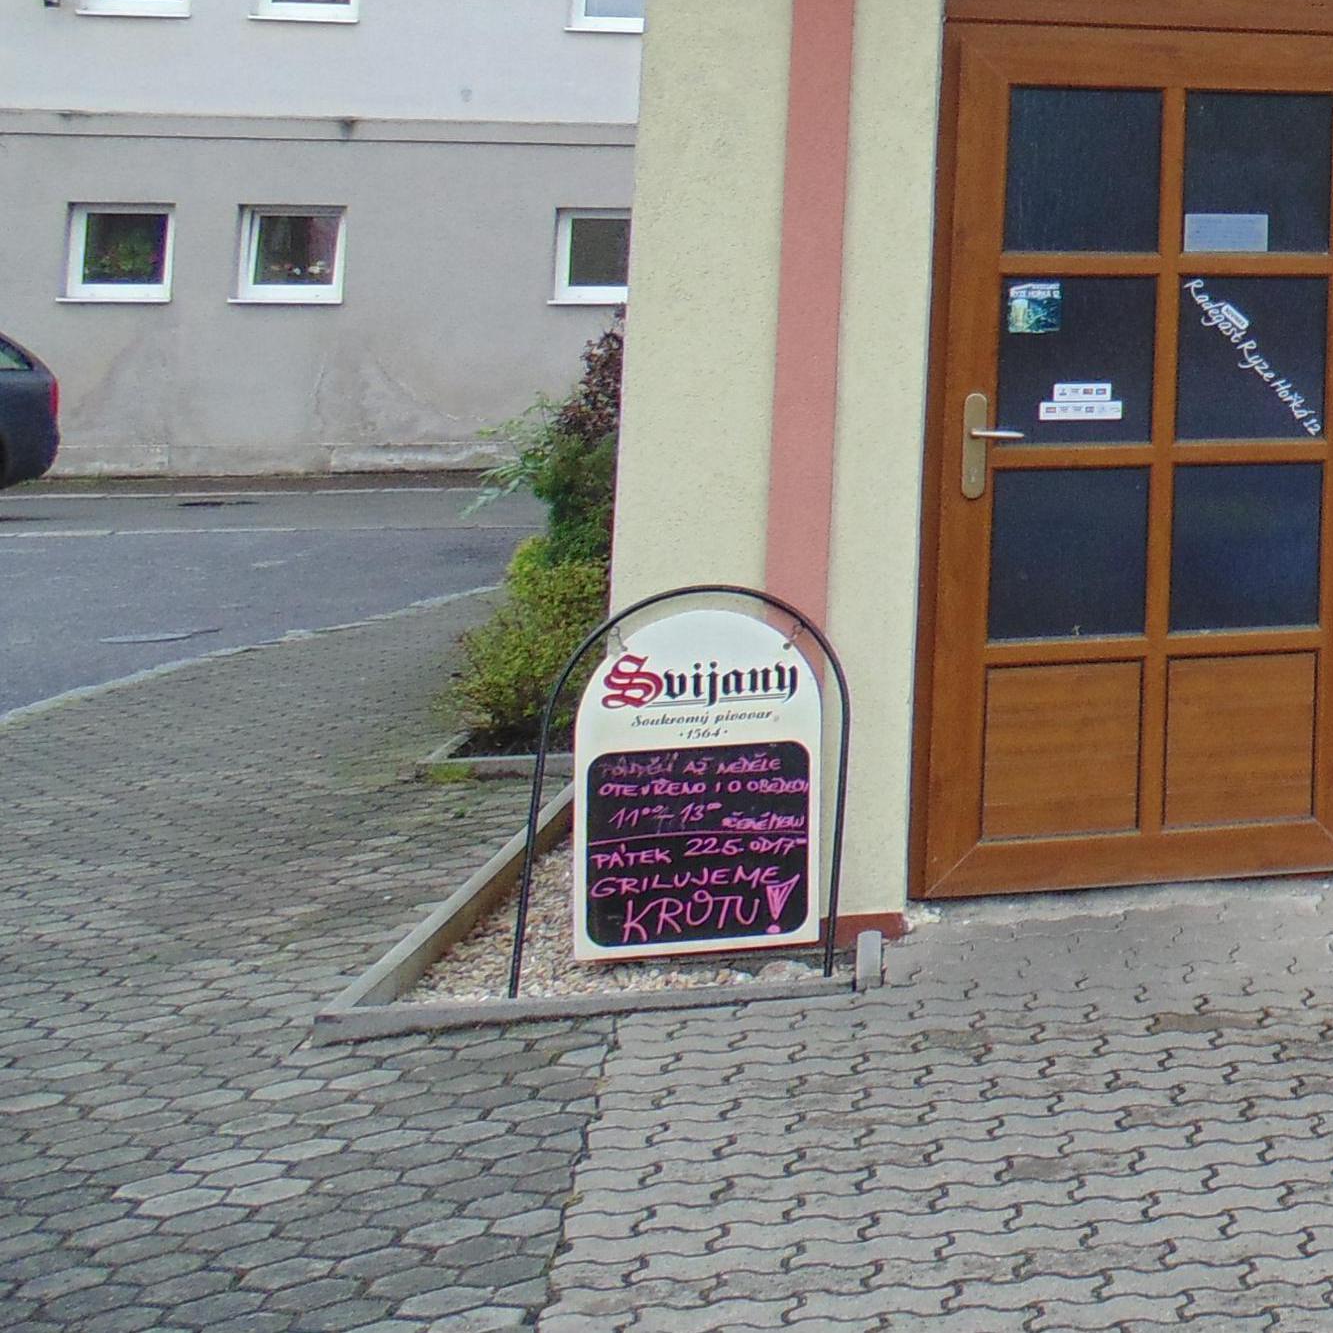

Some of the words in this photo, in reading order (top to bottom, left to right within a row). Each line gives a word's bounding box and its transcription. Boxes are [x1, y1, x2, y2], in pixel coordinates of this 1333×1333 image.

[1183, 278, 1247, 343] Radegast
[1236, 339, 1276, 382] Ryze
[1269, 378, 1316, 420] Hořká
[1302, 418, 1321, 436] 12
[602, 654, 799, 708] Svijany
[631, 712, 709, 727] Soukromý
[714, 710, 773, 724] pivovar
[686, 728, 721, 739] 1564
[682, 757, 713, 774] AŽ
[590, 843, 673, 869] PÁTEK
[591, 865, 782, 898] GRILUJEME
